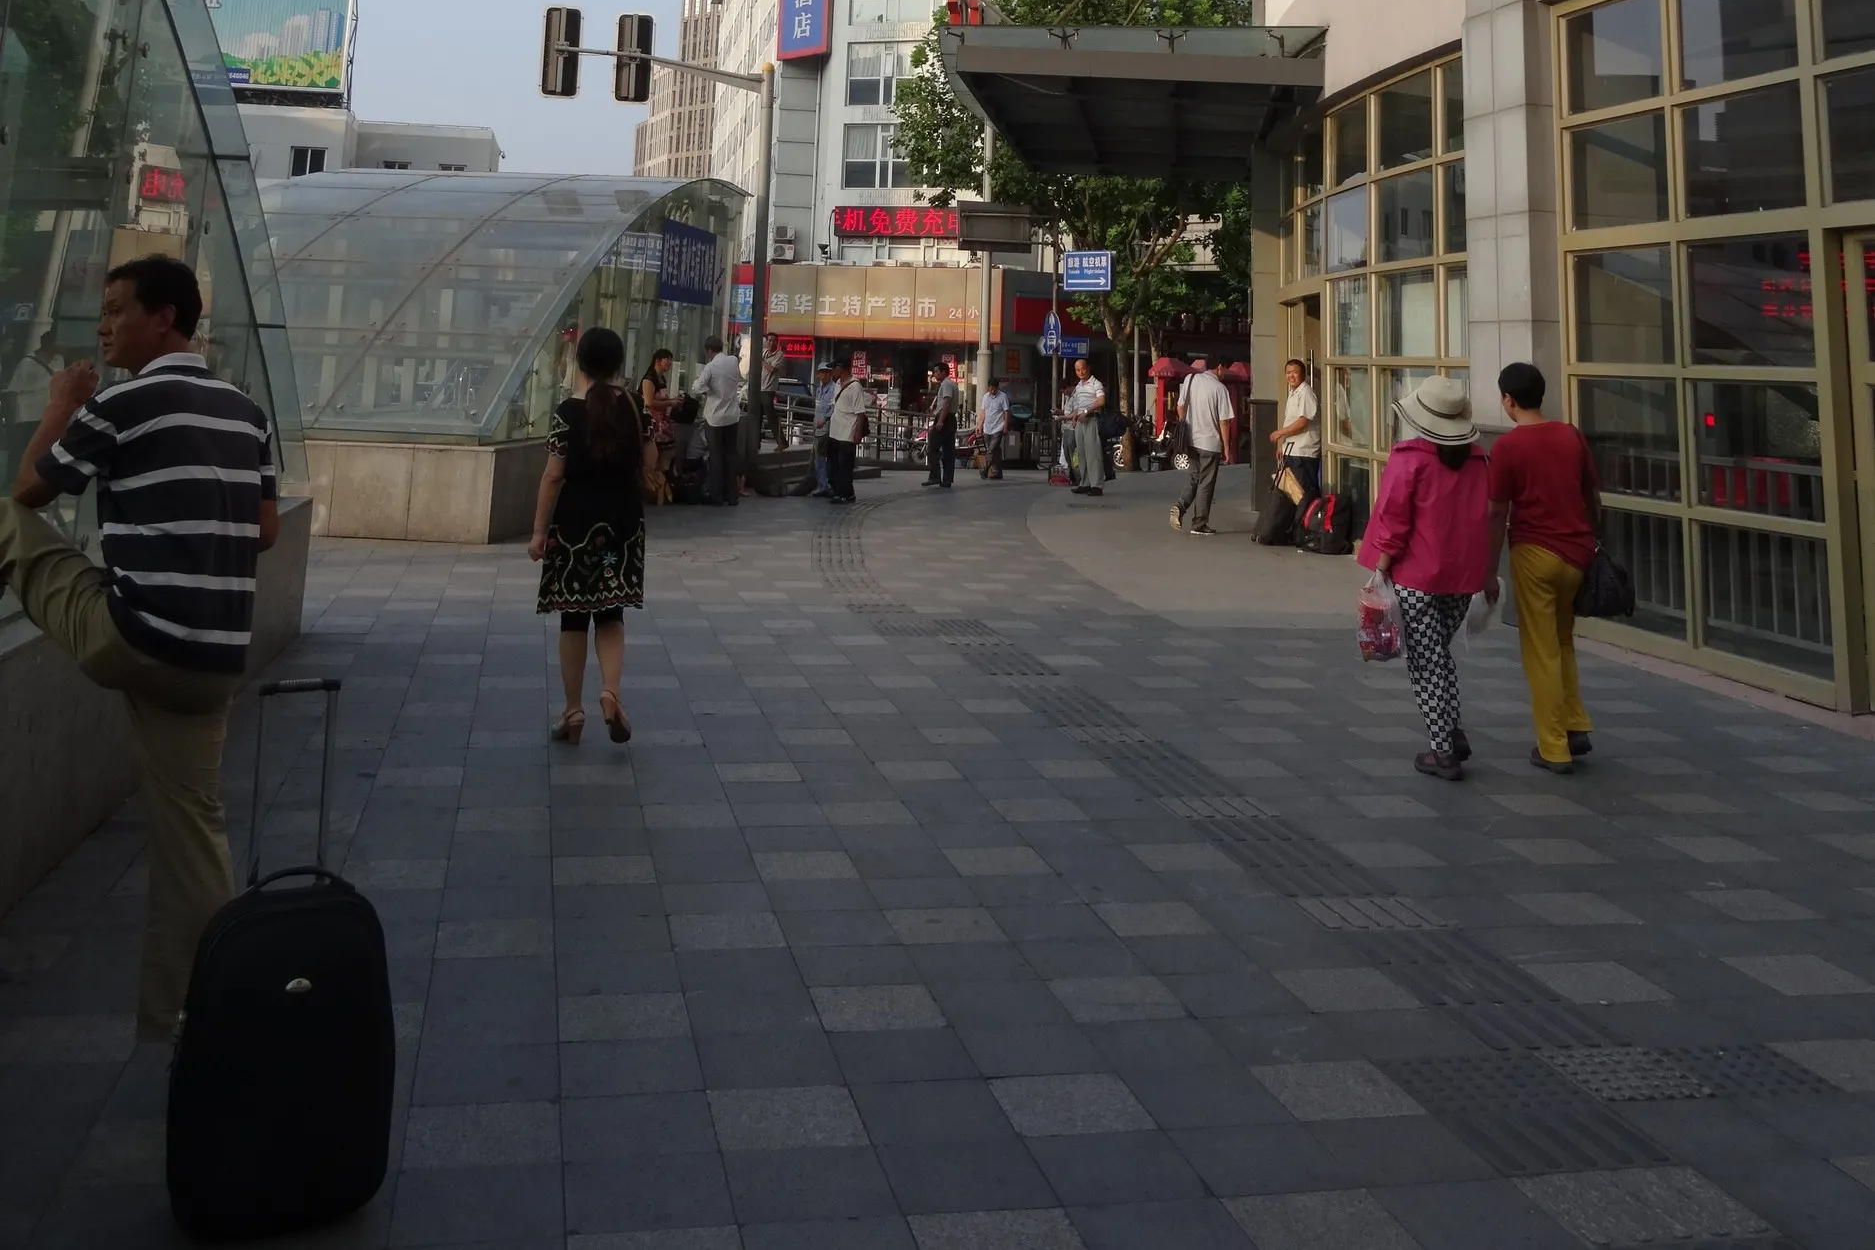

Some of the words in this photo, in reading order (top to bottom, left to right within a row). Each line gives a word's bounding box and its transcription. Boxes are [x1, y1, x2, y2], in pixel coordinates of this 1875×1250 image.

[835, 208, 958, 235] 机免费充
[770, 293, 937, 318] 绮华土特产超市
